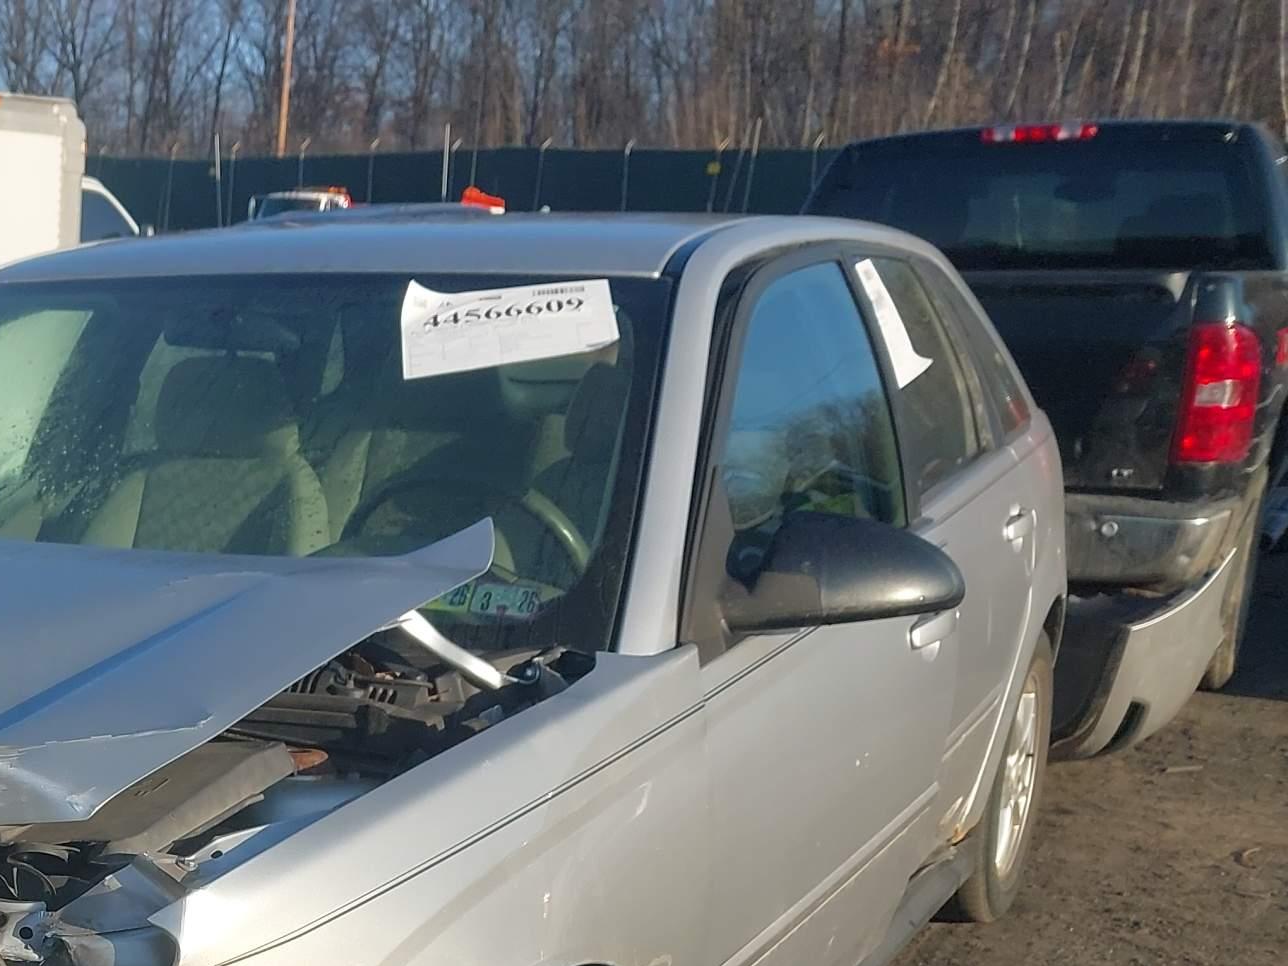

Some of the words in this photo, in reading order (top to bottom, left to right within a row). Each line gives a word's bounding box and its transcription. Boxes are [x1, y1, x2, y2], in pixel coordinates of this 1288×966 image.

[424, 297, 585, 328] 44566609
[479, 591, 493, 611] 3
[517, 590, 538, 613] 26
